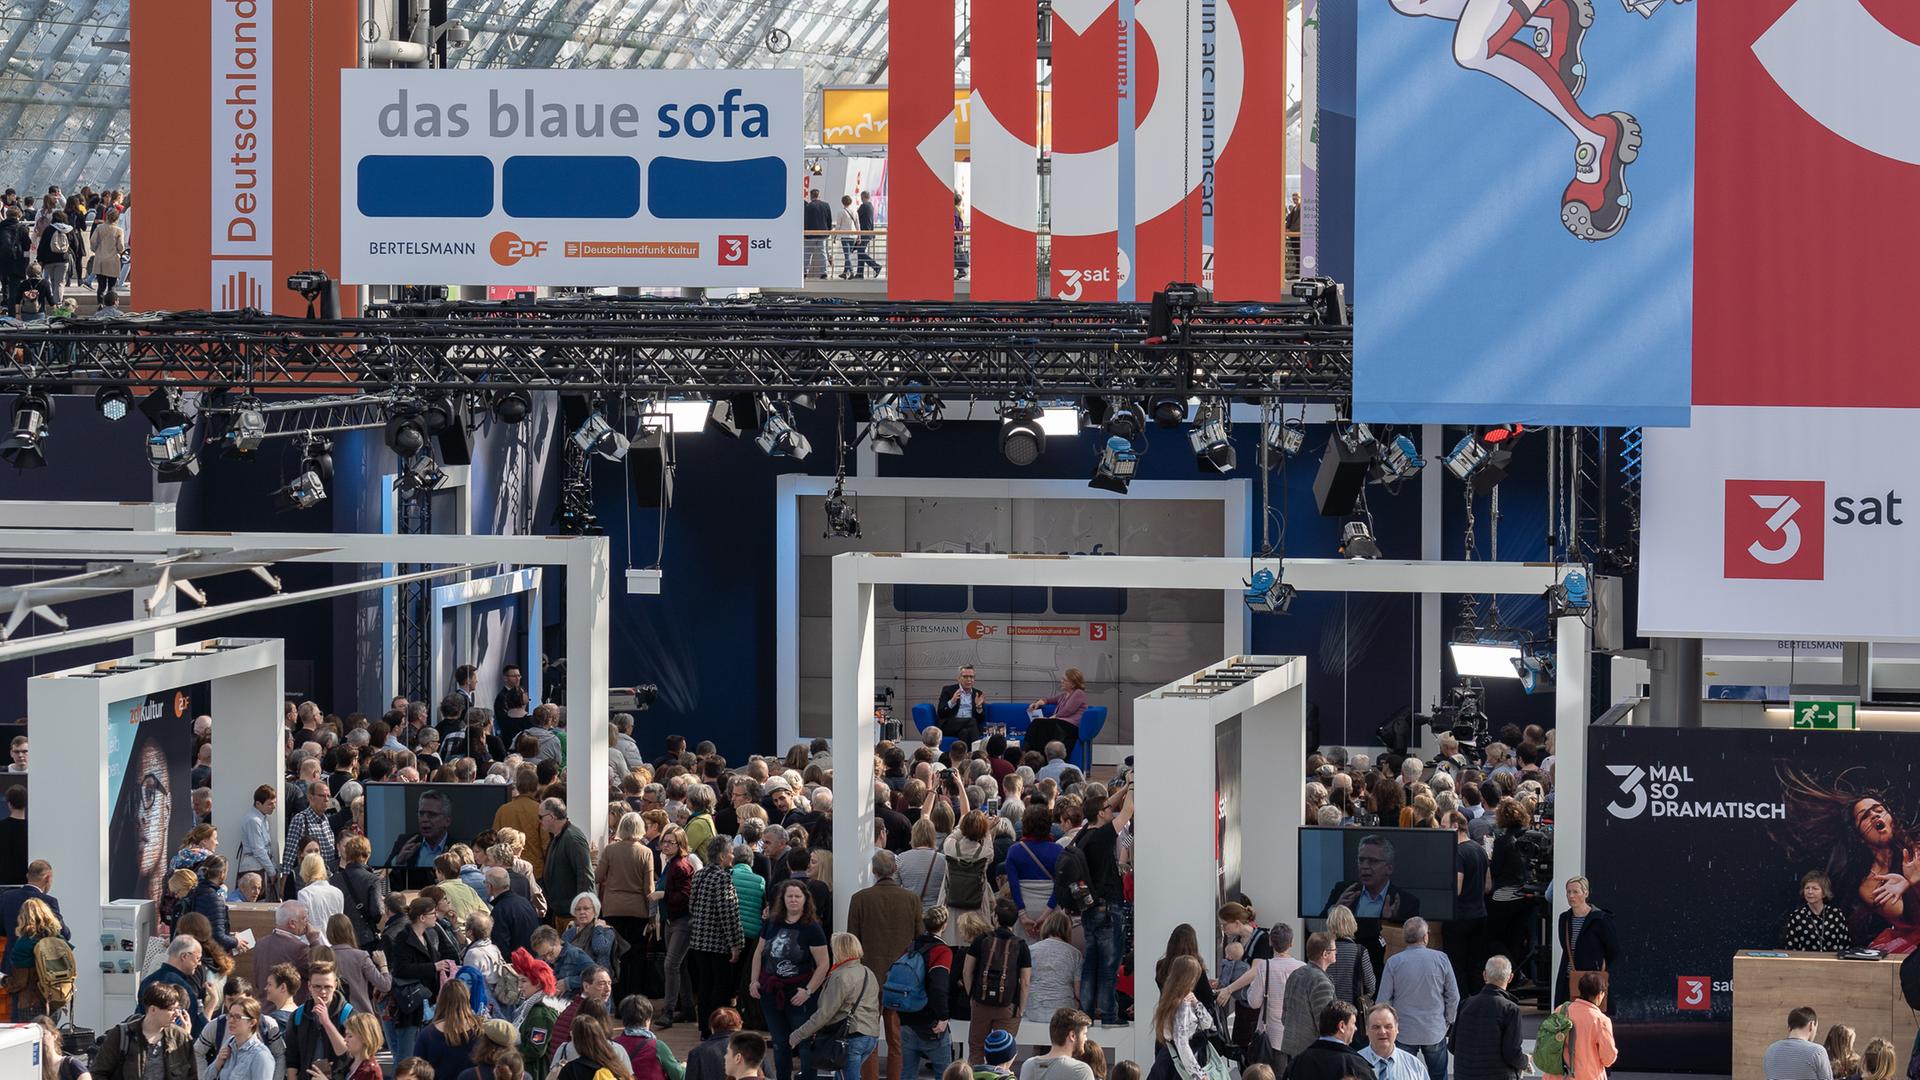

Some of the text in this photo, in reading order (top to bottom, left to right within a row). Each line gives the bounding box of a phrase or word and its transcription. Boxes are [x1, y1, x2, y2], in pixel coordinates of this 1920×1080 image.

[378, 88, 770, 138] das blaue sofa
[369, 242, 476, 255] BERTELSMANN
[583, 244, 666, 255] Deutschlandfunk
[667, 245, 697, 255] Kultur
[1605, 765, 1694, 820] 3 MAL
[1650, 783, 1679, 800] SO
[1651, 801, 1786, 819] DRAMATISCH
